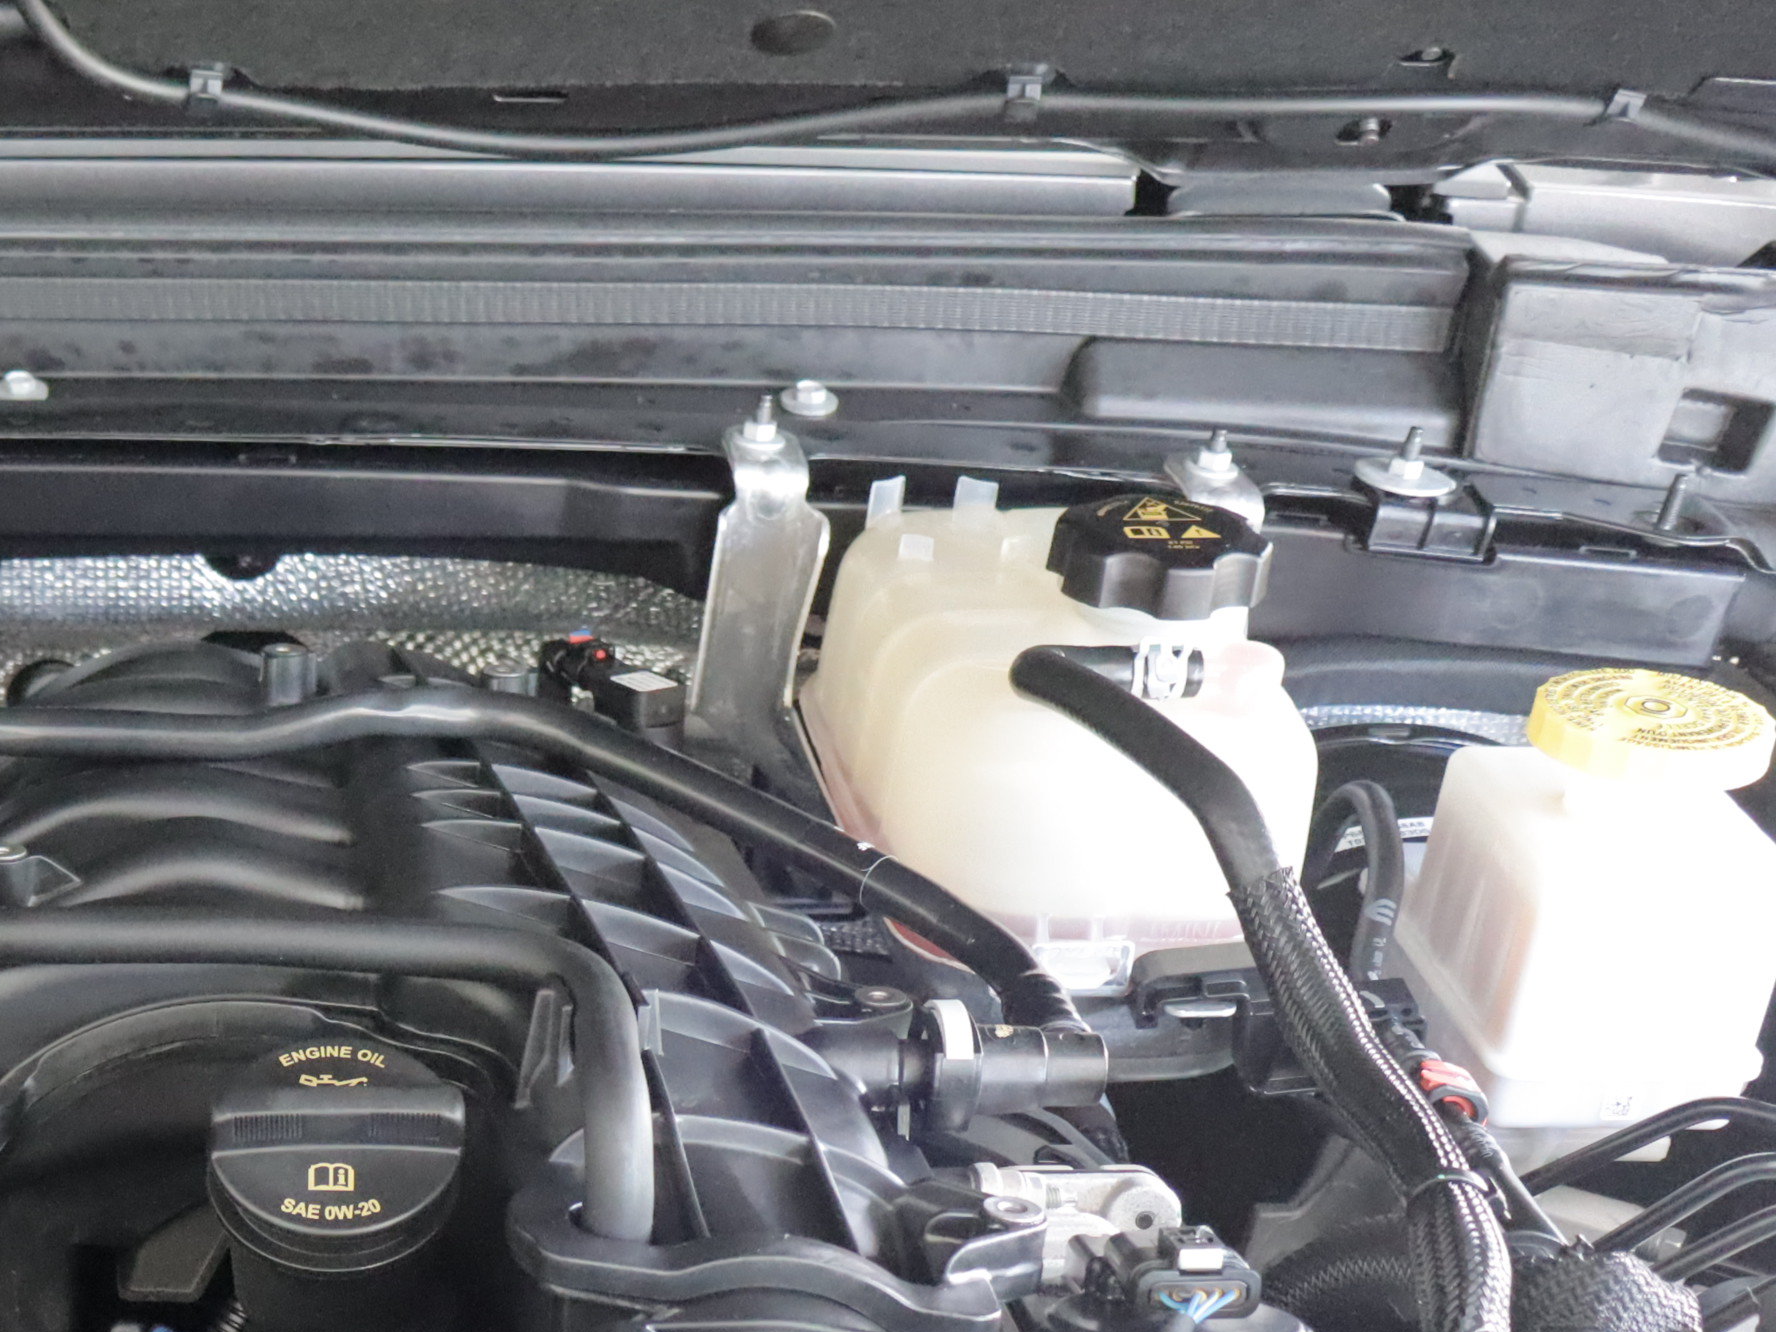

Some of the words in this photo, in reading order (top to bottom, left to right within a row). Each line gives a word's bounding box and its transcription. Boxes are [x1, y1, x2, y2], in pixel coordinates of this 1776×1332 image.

[278, 1045, 353, 1067] ENGINE
[357, 1048, 386, 1068] OIL
[280, 1197, 320, 1220] SAE
[324, 1197, 381, 1220] 0W-20
